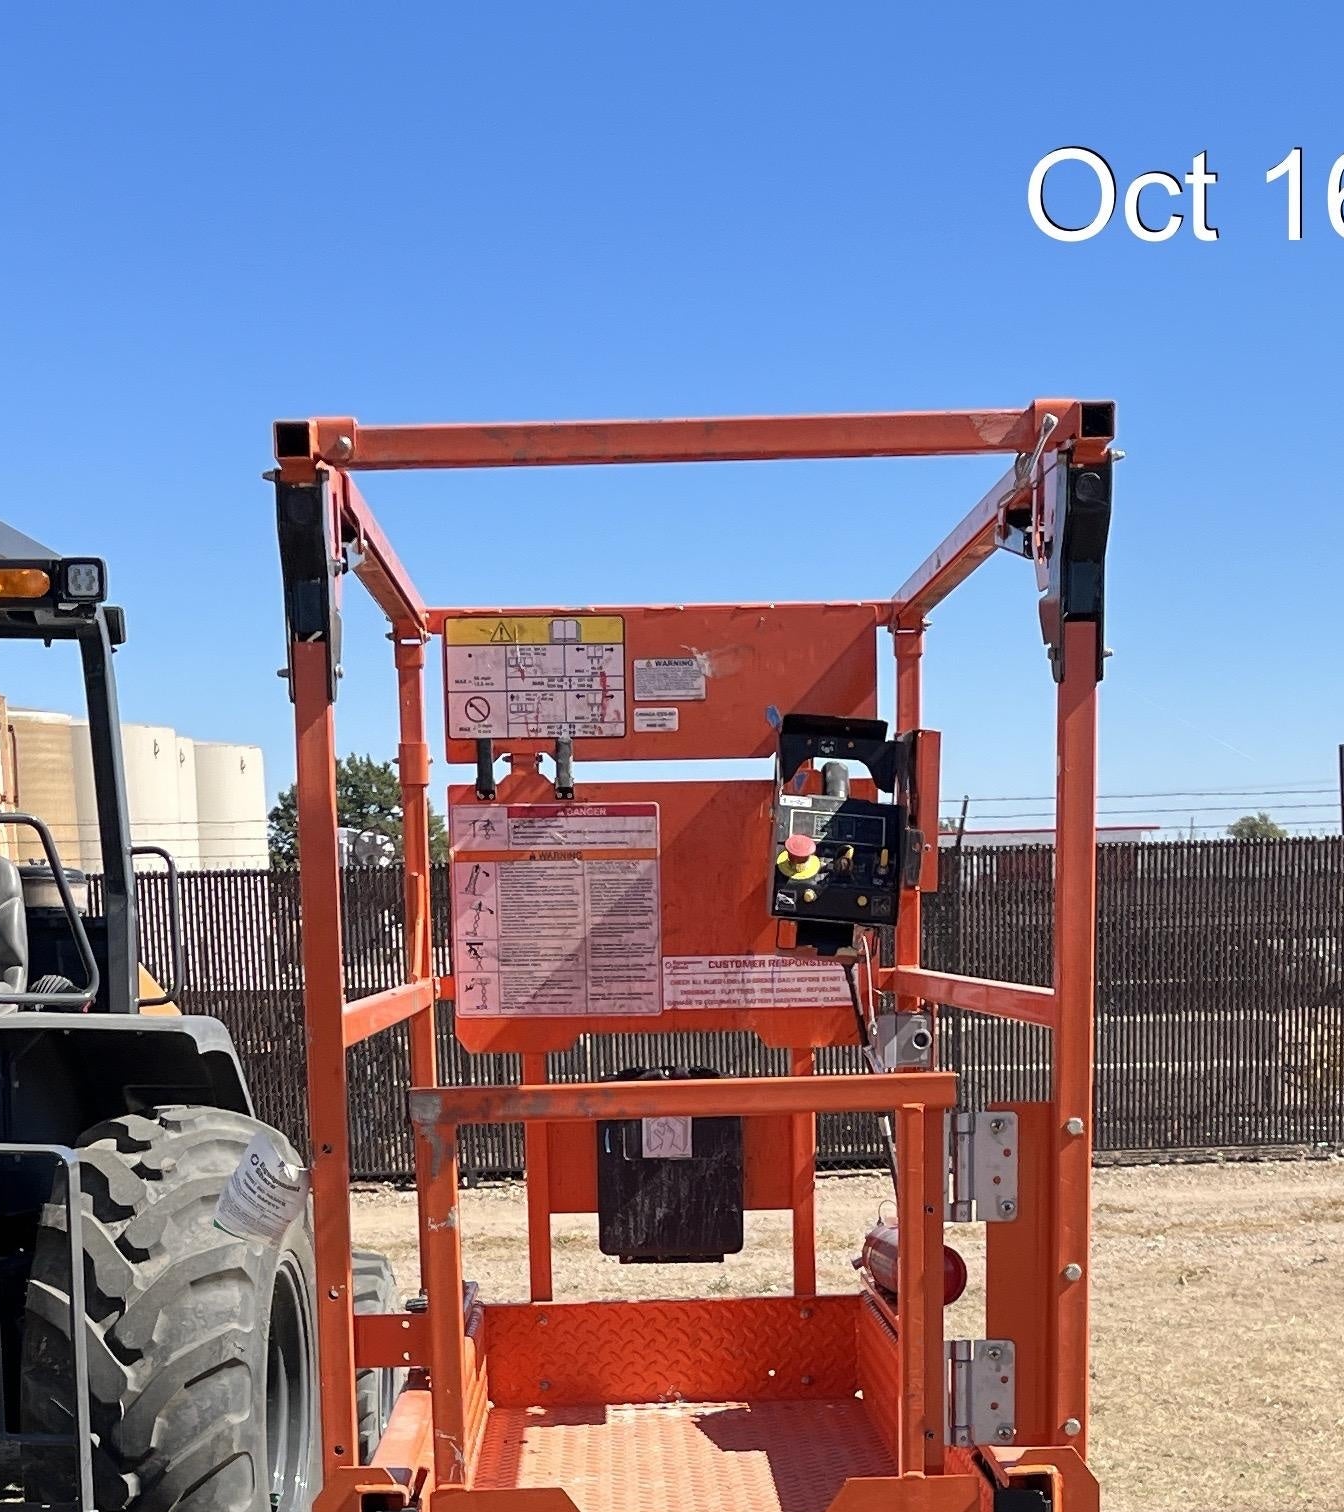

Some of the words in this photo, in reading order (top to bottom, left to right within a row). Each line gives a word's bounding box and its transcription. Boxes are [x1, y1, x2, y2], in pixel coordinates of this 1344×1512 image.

[565, 807, 607, 816] DANGER
[539, 850, 583, 860] WARNING
[708, 959, 766, 969] CUSTOMER
